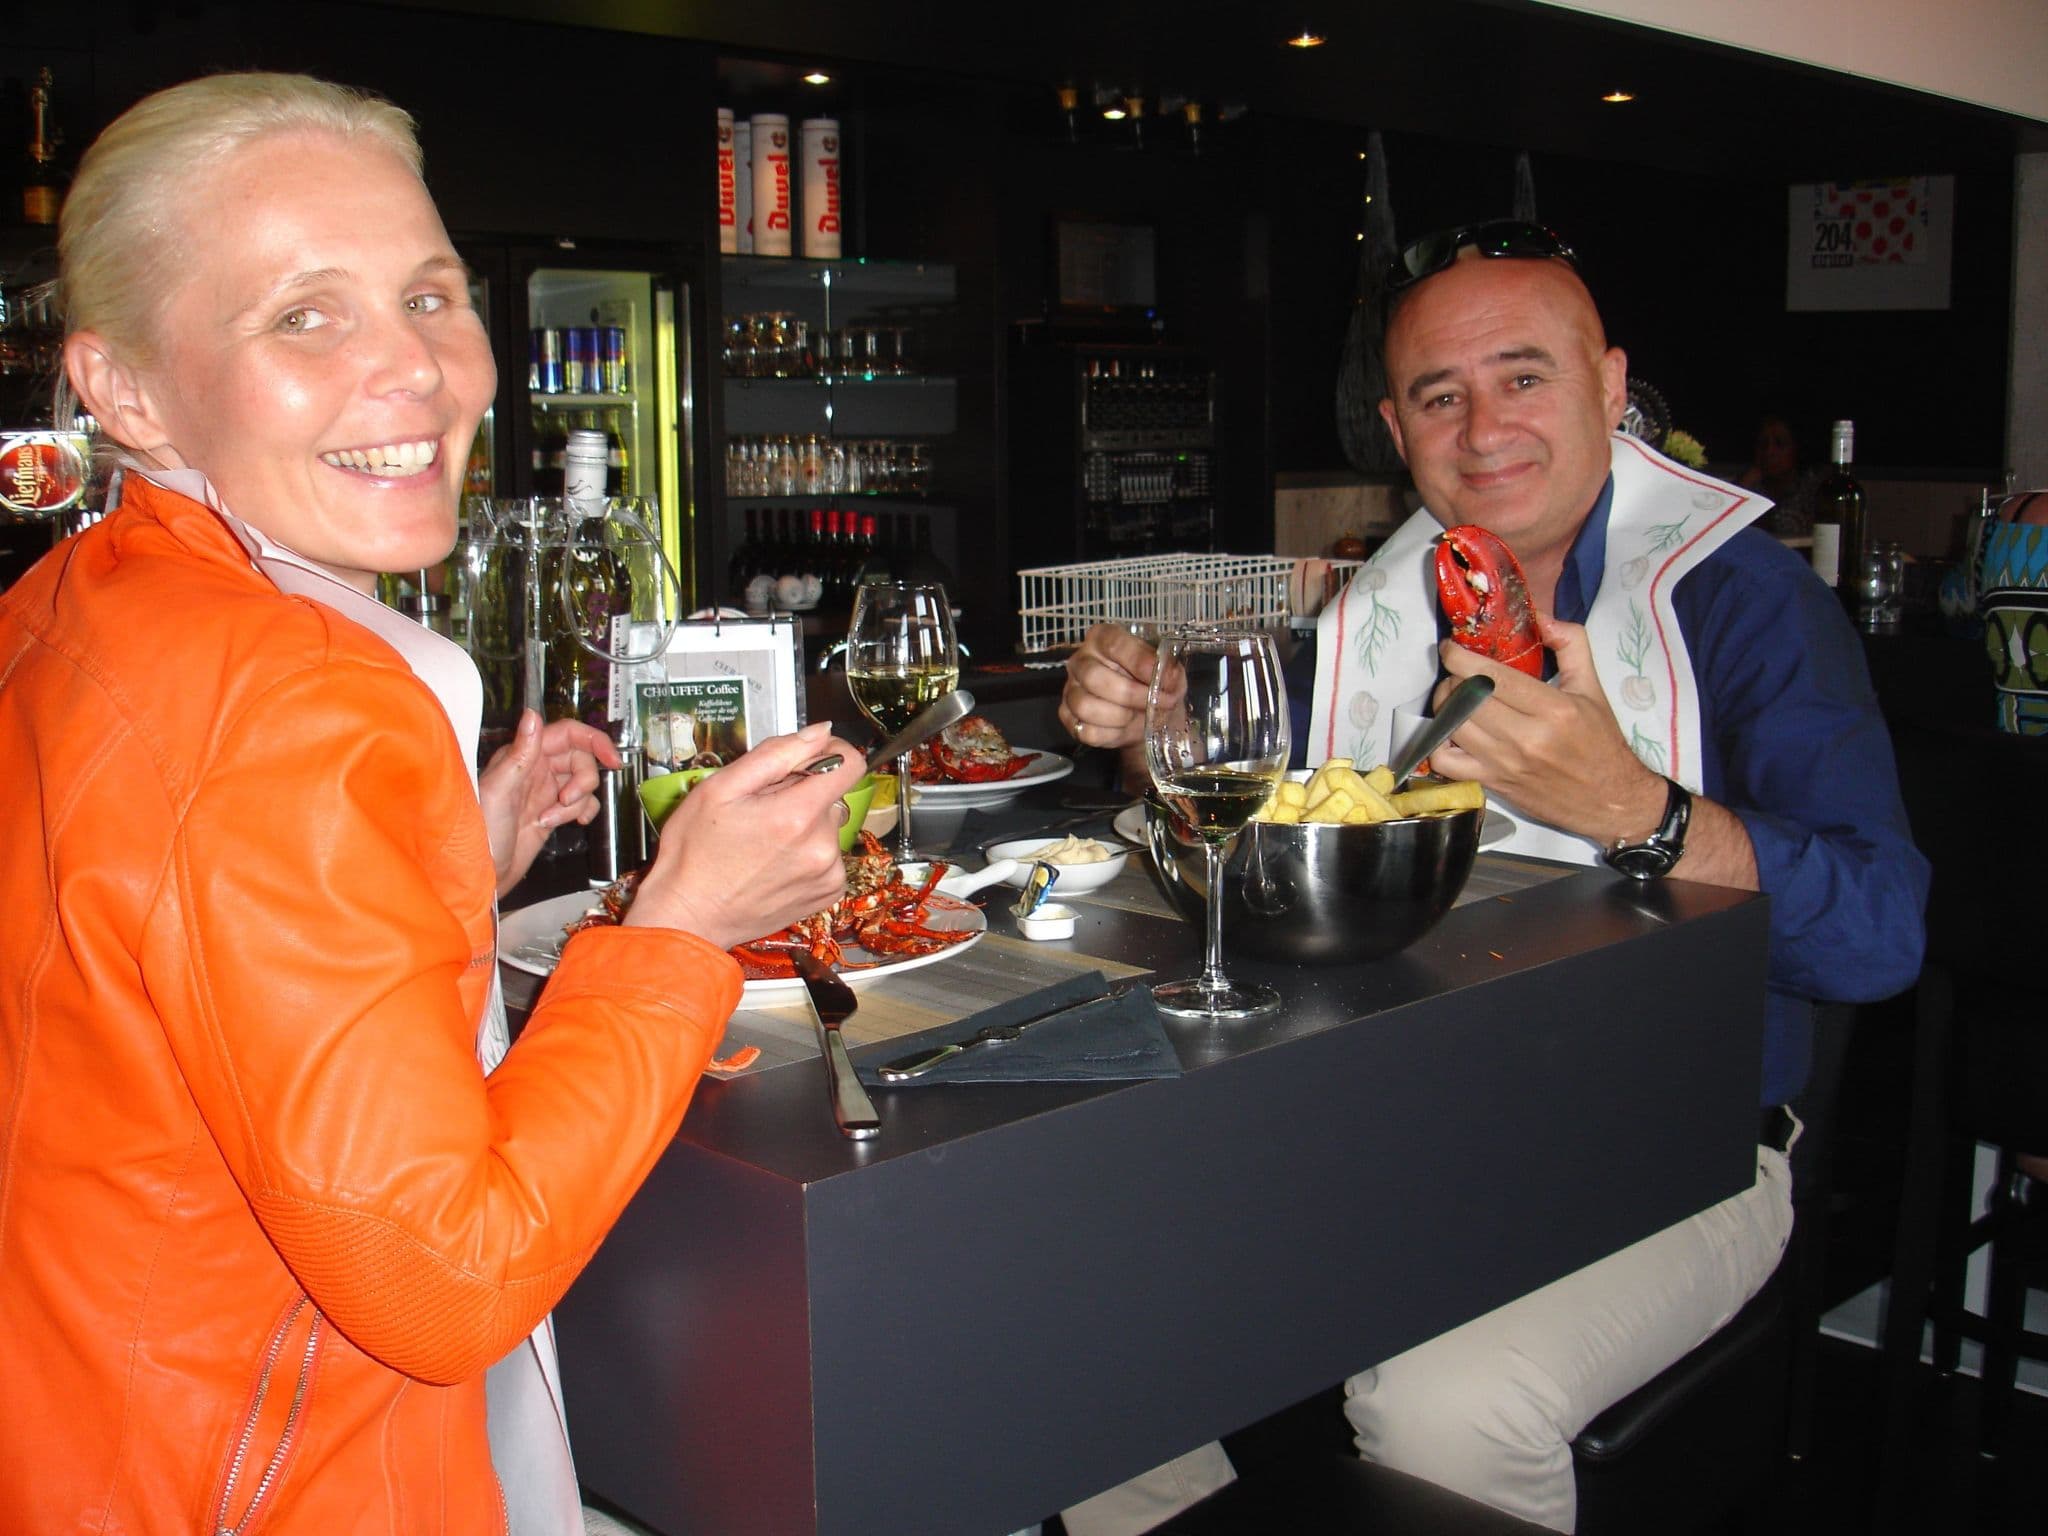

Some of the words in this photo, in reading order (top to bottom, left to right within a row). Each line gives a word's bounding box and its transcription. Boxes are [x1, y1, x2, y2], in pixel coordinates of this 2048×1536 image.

[767, 155, 789, 230] Duvel
[818, 159, 840, 233] Duvel
[1815, 223, 1852, 251] 204
[9, 446, 41, 505] Liefmans
[643, 685, 703, 697] CHOUFFE
[707, 684, 739, 695] Coffee
